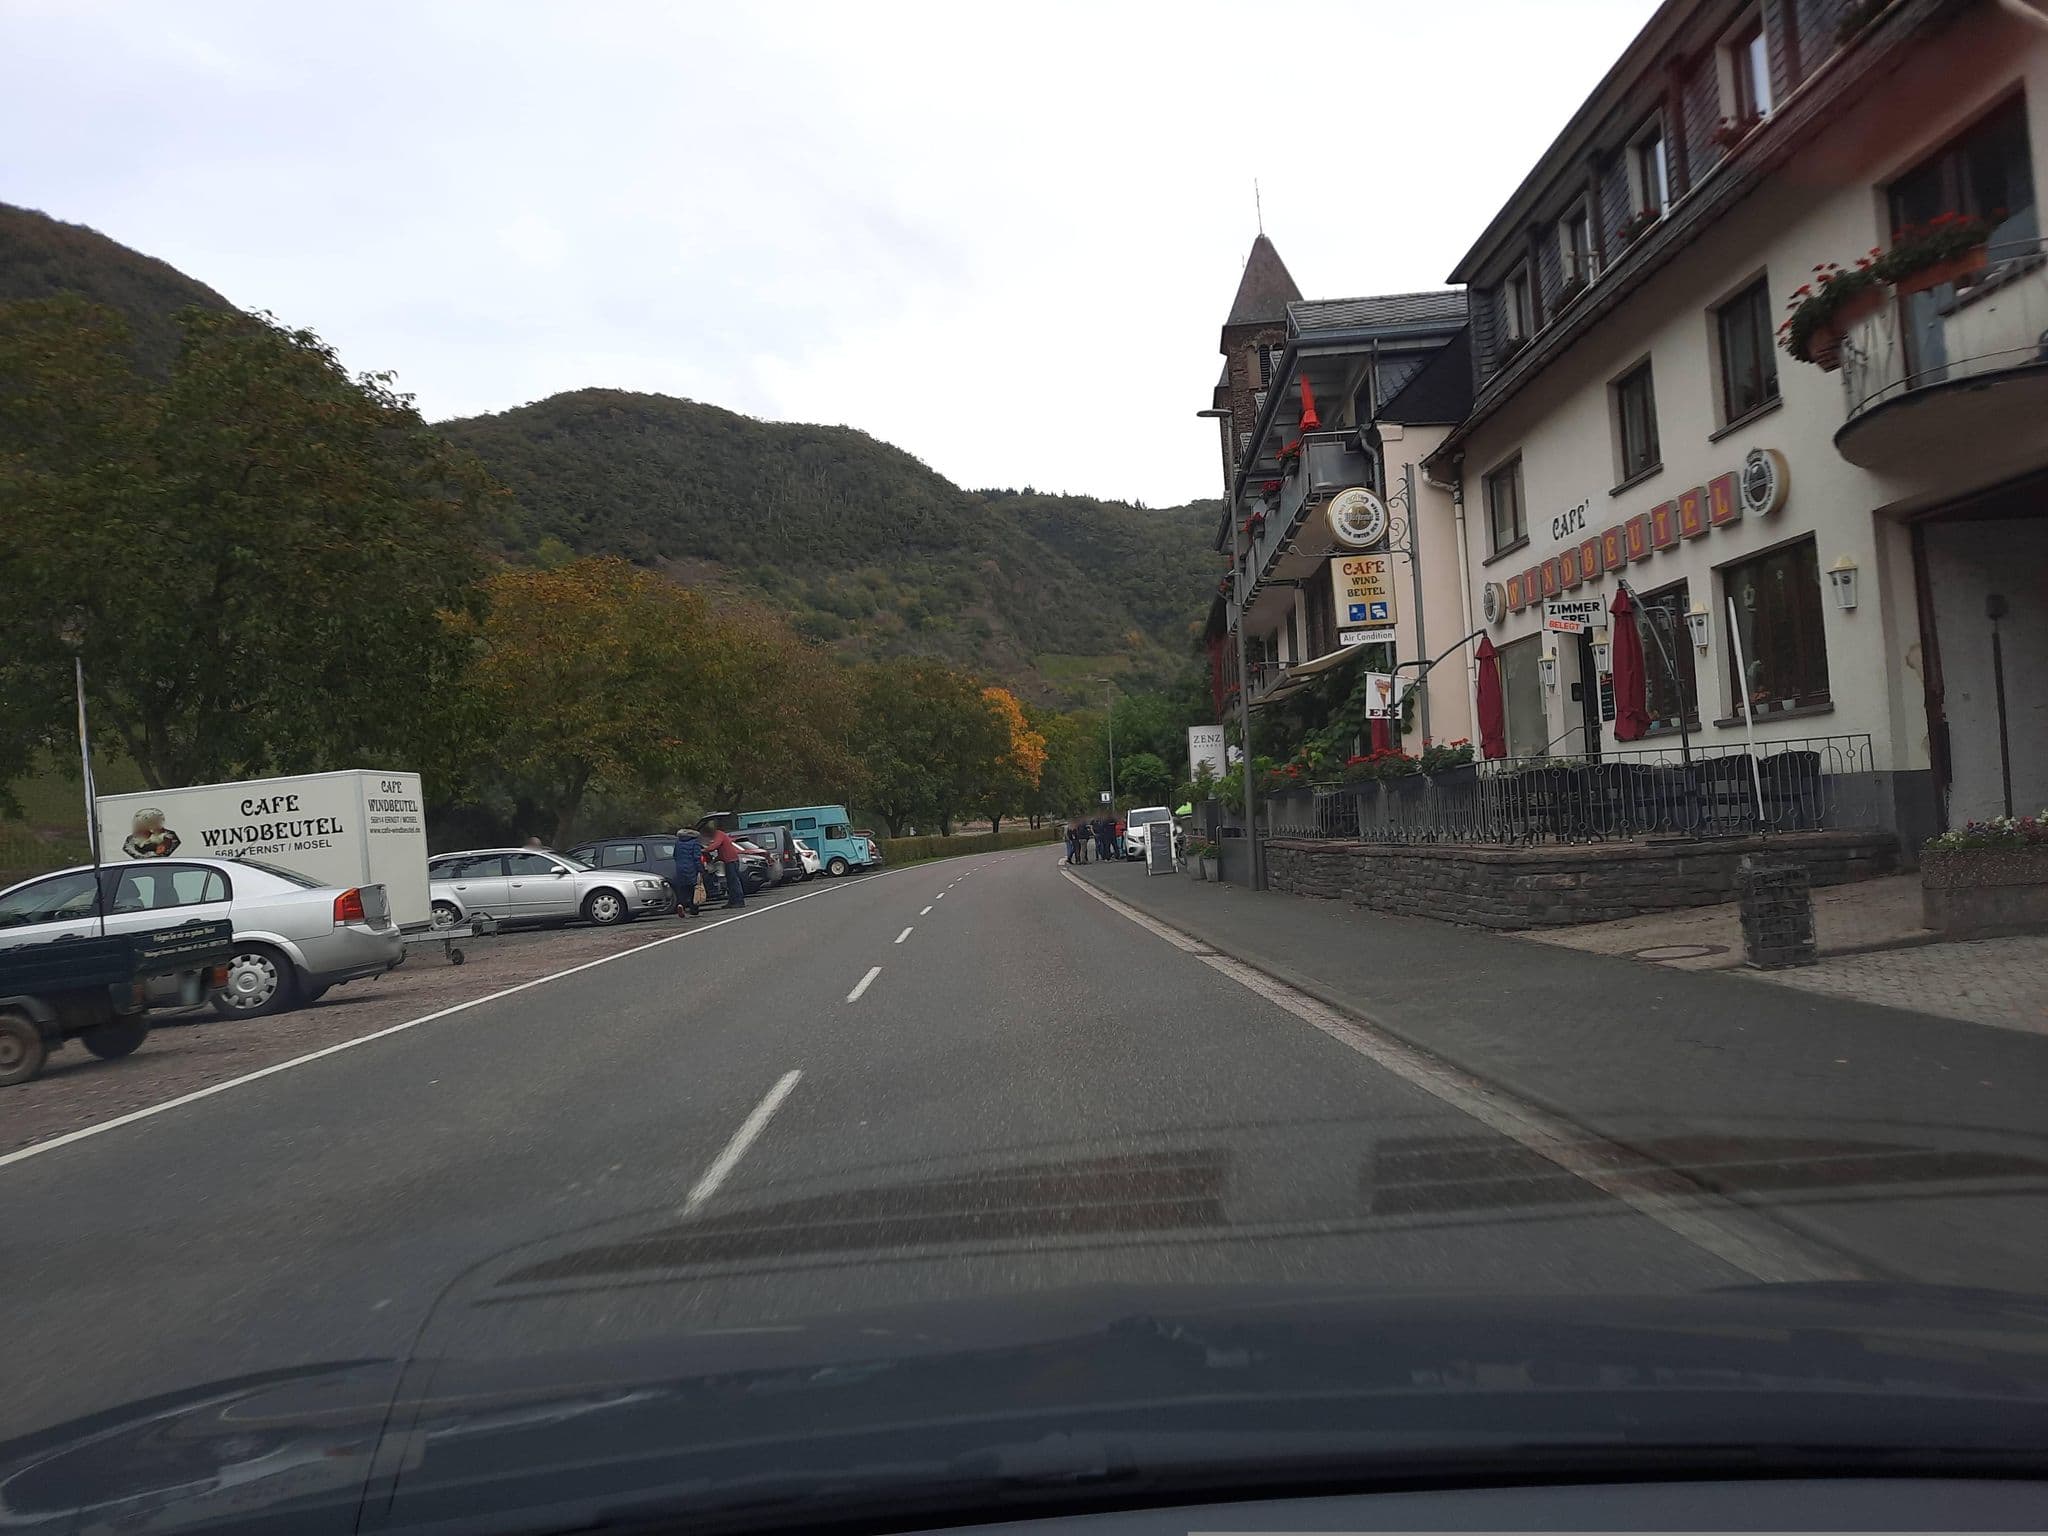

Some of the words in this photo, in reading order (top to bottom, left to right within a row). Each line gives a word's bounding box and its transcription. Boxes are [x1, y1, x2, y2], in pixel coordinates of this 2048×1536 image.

[1507, 486, 1730, 608] WINDBEUTEL
[1342, 560, 1386, 576] CAFE
[1346, 586, 1386, 598] BEUTEL
[1548, 601, 1601, 615] ZIMMER
[1549, 620, 1581, 631] BELEGT
[1343, 633, 1355, 642] Air
[1356, 631, 1393, 641] Condition
[1193, 734, 1221, 744] ZENZ
[381, 780, 403, 794] CAFE
[241, 794, 300, 817] CAFE
[367, 799, 419, 812] WINDBEUTEL
[201, 816, 344, 848] WINDBEUTEL
[249, 843, 286, 856] ERNST
[294, 839, 333, 851] MOSEL
